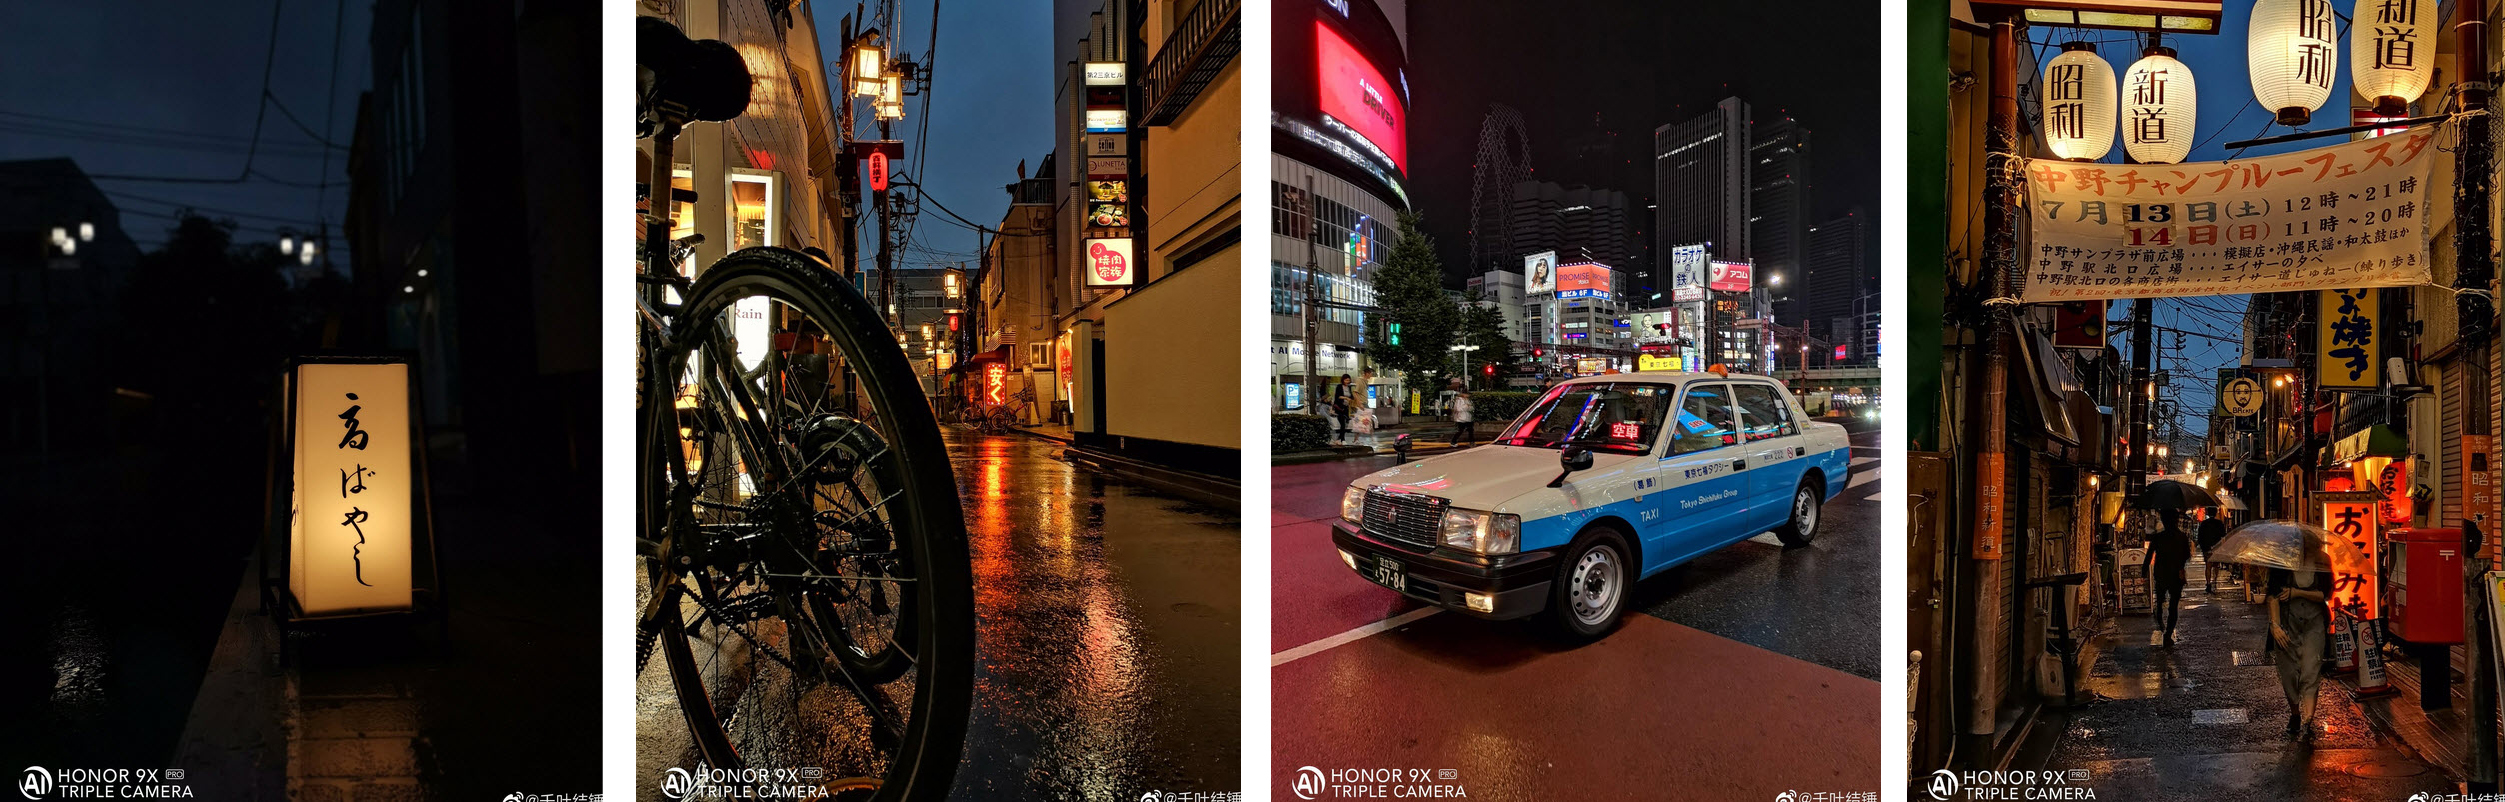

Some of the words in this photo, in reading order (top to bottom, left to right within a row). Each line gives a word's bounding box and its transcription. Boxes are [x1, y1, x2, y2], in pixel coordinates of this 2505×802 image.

[2296, 0, 2333, 90] 昭和
[2050, 64, 2084, 140] 昭和
[2132, 67, 2169, 144] 新道
[2034, 133, 2433, 196] 中野チャンプルーフェスタ
[1674, 248, 1703, 264] カラオケ
[1559, 272, 1590, 282] PROMISE
[1729, 270, 1749, 280] アコム
[1321, 350, 1351, 360] Network
[1612, 423, 1640, 440] 空車
[1680, 499, 1698, 511] Tokyo
[1723, 488, 1738, 499] Group
[1640, 507, 1659, 523] TAXI
[1379, 567, 1406, 592] 57-84
